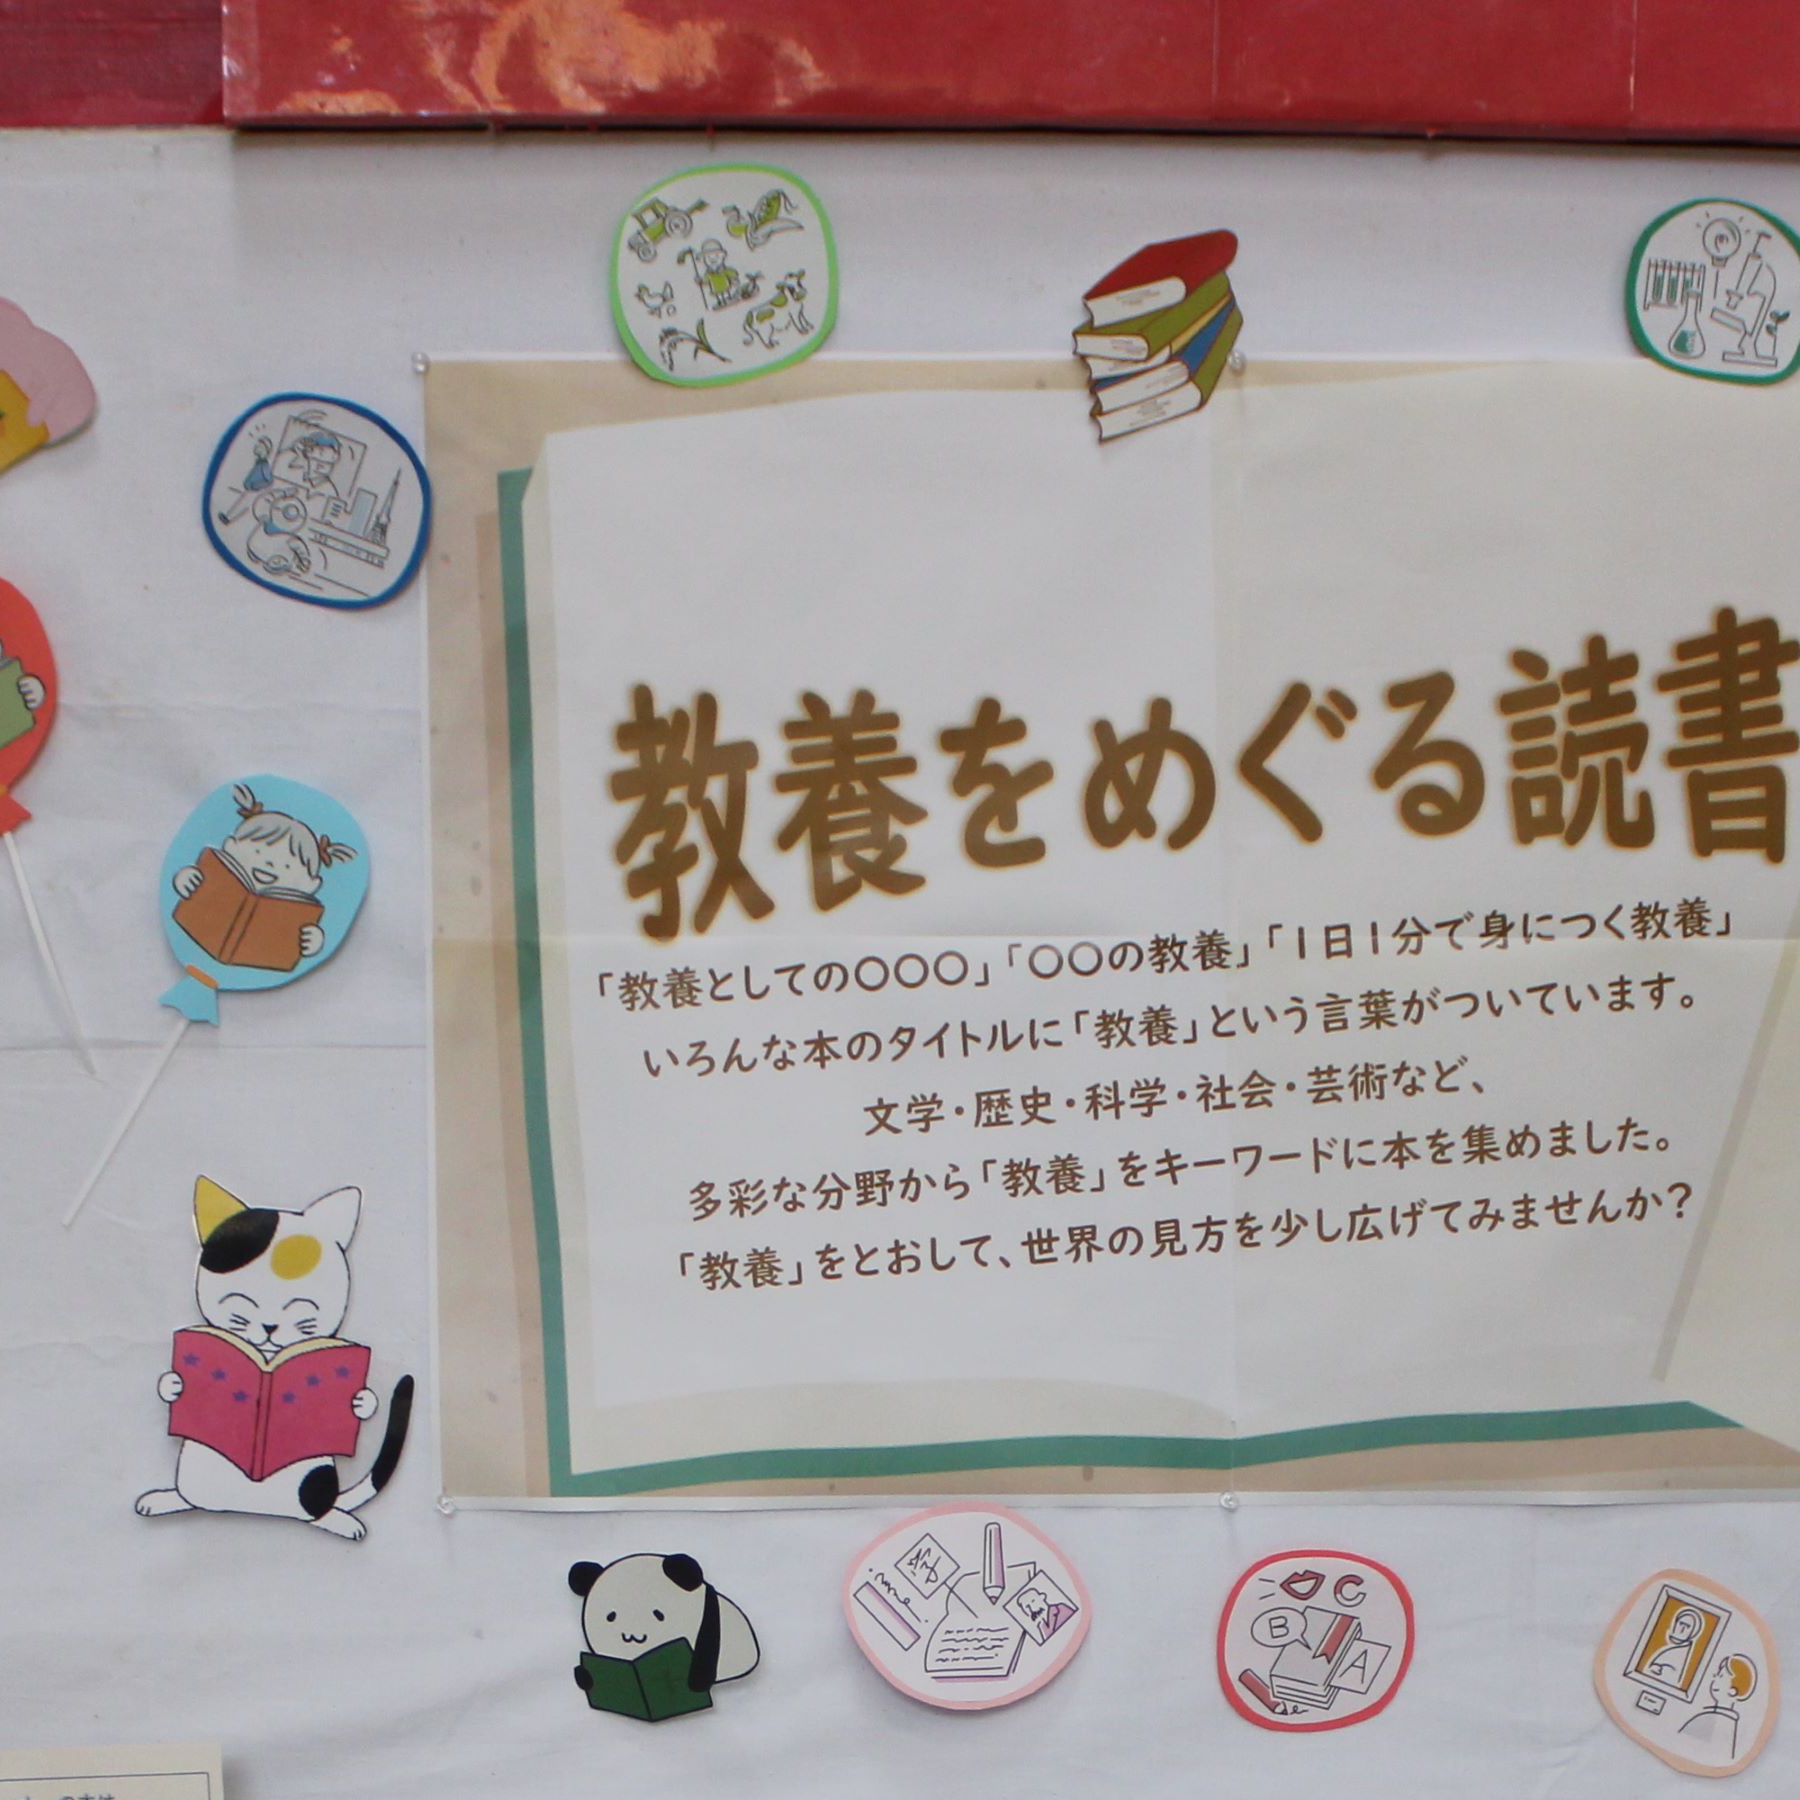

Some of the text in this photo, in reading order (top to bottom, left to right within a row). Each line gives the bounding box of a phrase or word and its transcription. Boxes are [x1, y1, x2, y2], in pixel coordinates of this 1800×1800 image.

[606, 605, 1800, 945] 教養をめぐる読書
[643, 976, 1700, 1080] いろんな本のタイトルに「教養」という言葉がついています。
[863, 1061, 1490, 1138] 文学・歴史・科学・社会・芸術など、
[688, 1124, 1676, 1223] 多彩な分野から「教養」をキーワードに本を集めました。
[677, 1180, 1694, 1294] 「教養」をとおして、世界の見方を少し広げてみませんか?
[1269, 1615, 1289, 1639] B
[1338, 1649, 1368, 1684] A
